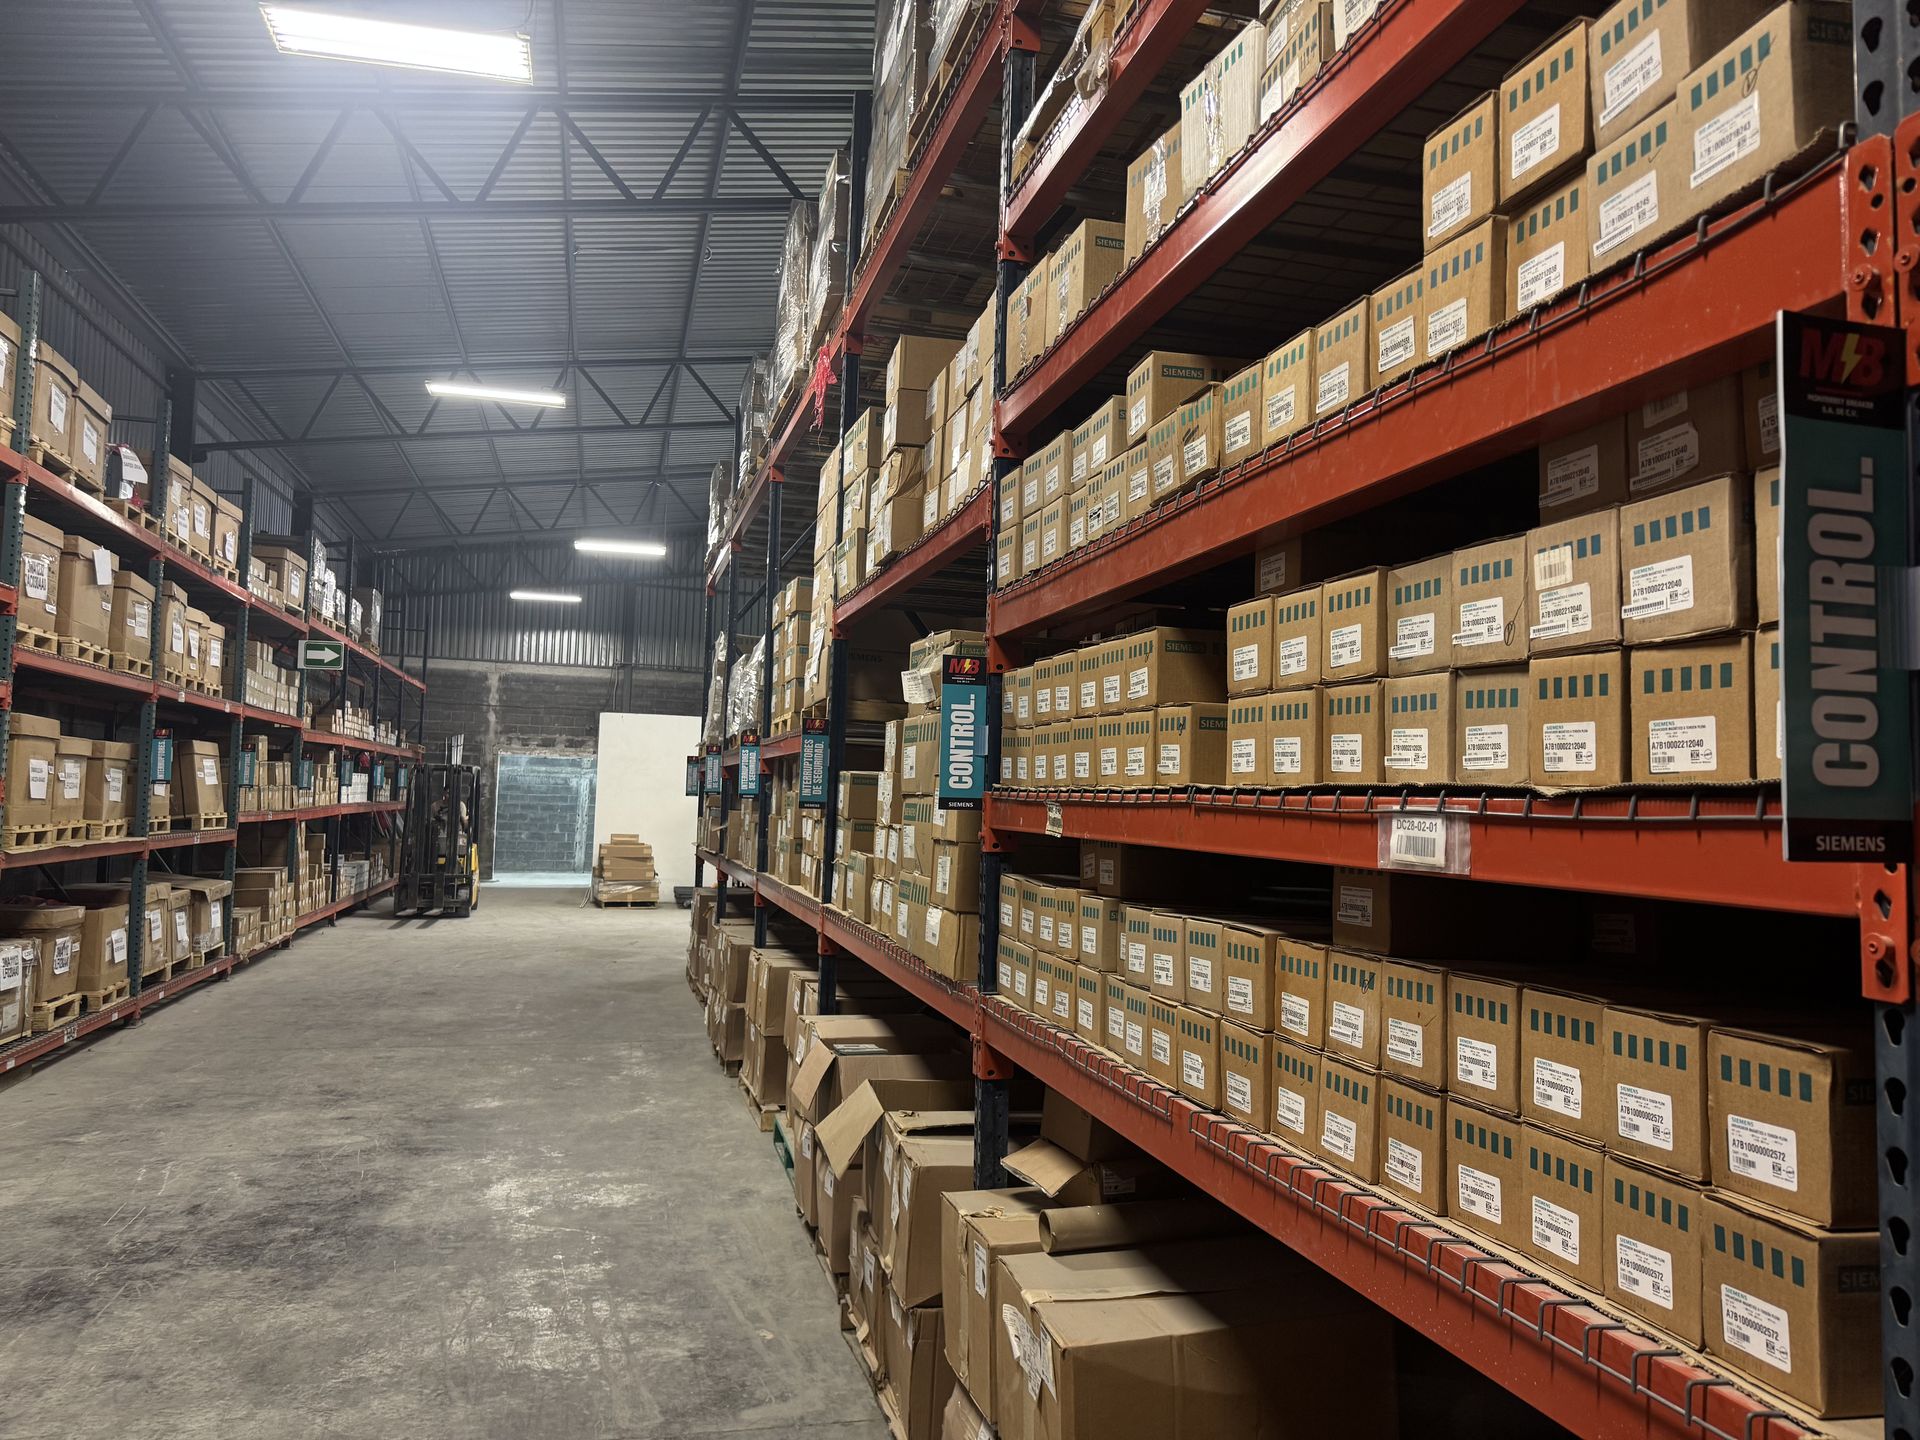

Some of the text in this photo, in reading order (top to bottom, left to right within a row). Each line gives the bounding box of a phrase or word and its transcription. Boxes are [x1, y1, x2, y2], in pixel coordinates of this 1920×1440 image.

[1163, 367, 1203, 379] SIEMENS
[1632, 578, 1683, 598] A7B10002212040
[1541, 603, 1583, 619] A7B10002212040
[1807, 457, 1880, 789] CONTROL.
[949, 657, 980, 675] MB
[948, 693, 976, 789] CONTROL.
[1544, 741, 1587, 751] A7B10002212040
[1651, 738, 1704, 750] A7B10002212040
[802, 739, 814, 796] INTERRUPTORES
[813, 785, 822, 795] DE
[1396, 819, 1438, 833] DC28-02-01
[1816, 834, 1886, 853] SIEMENS
[1731, 1116, 1754, 1127] SIEMENS
